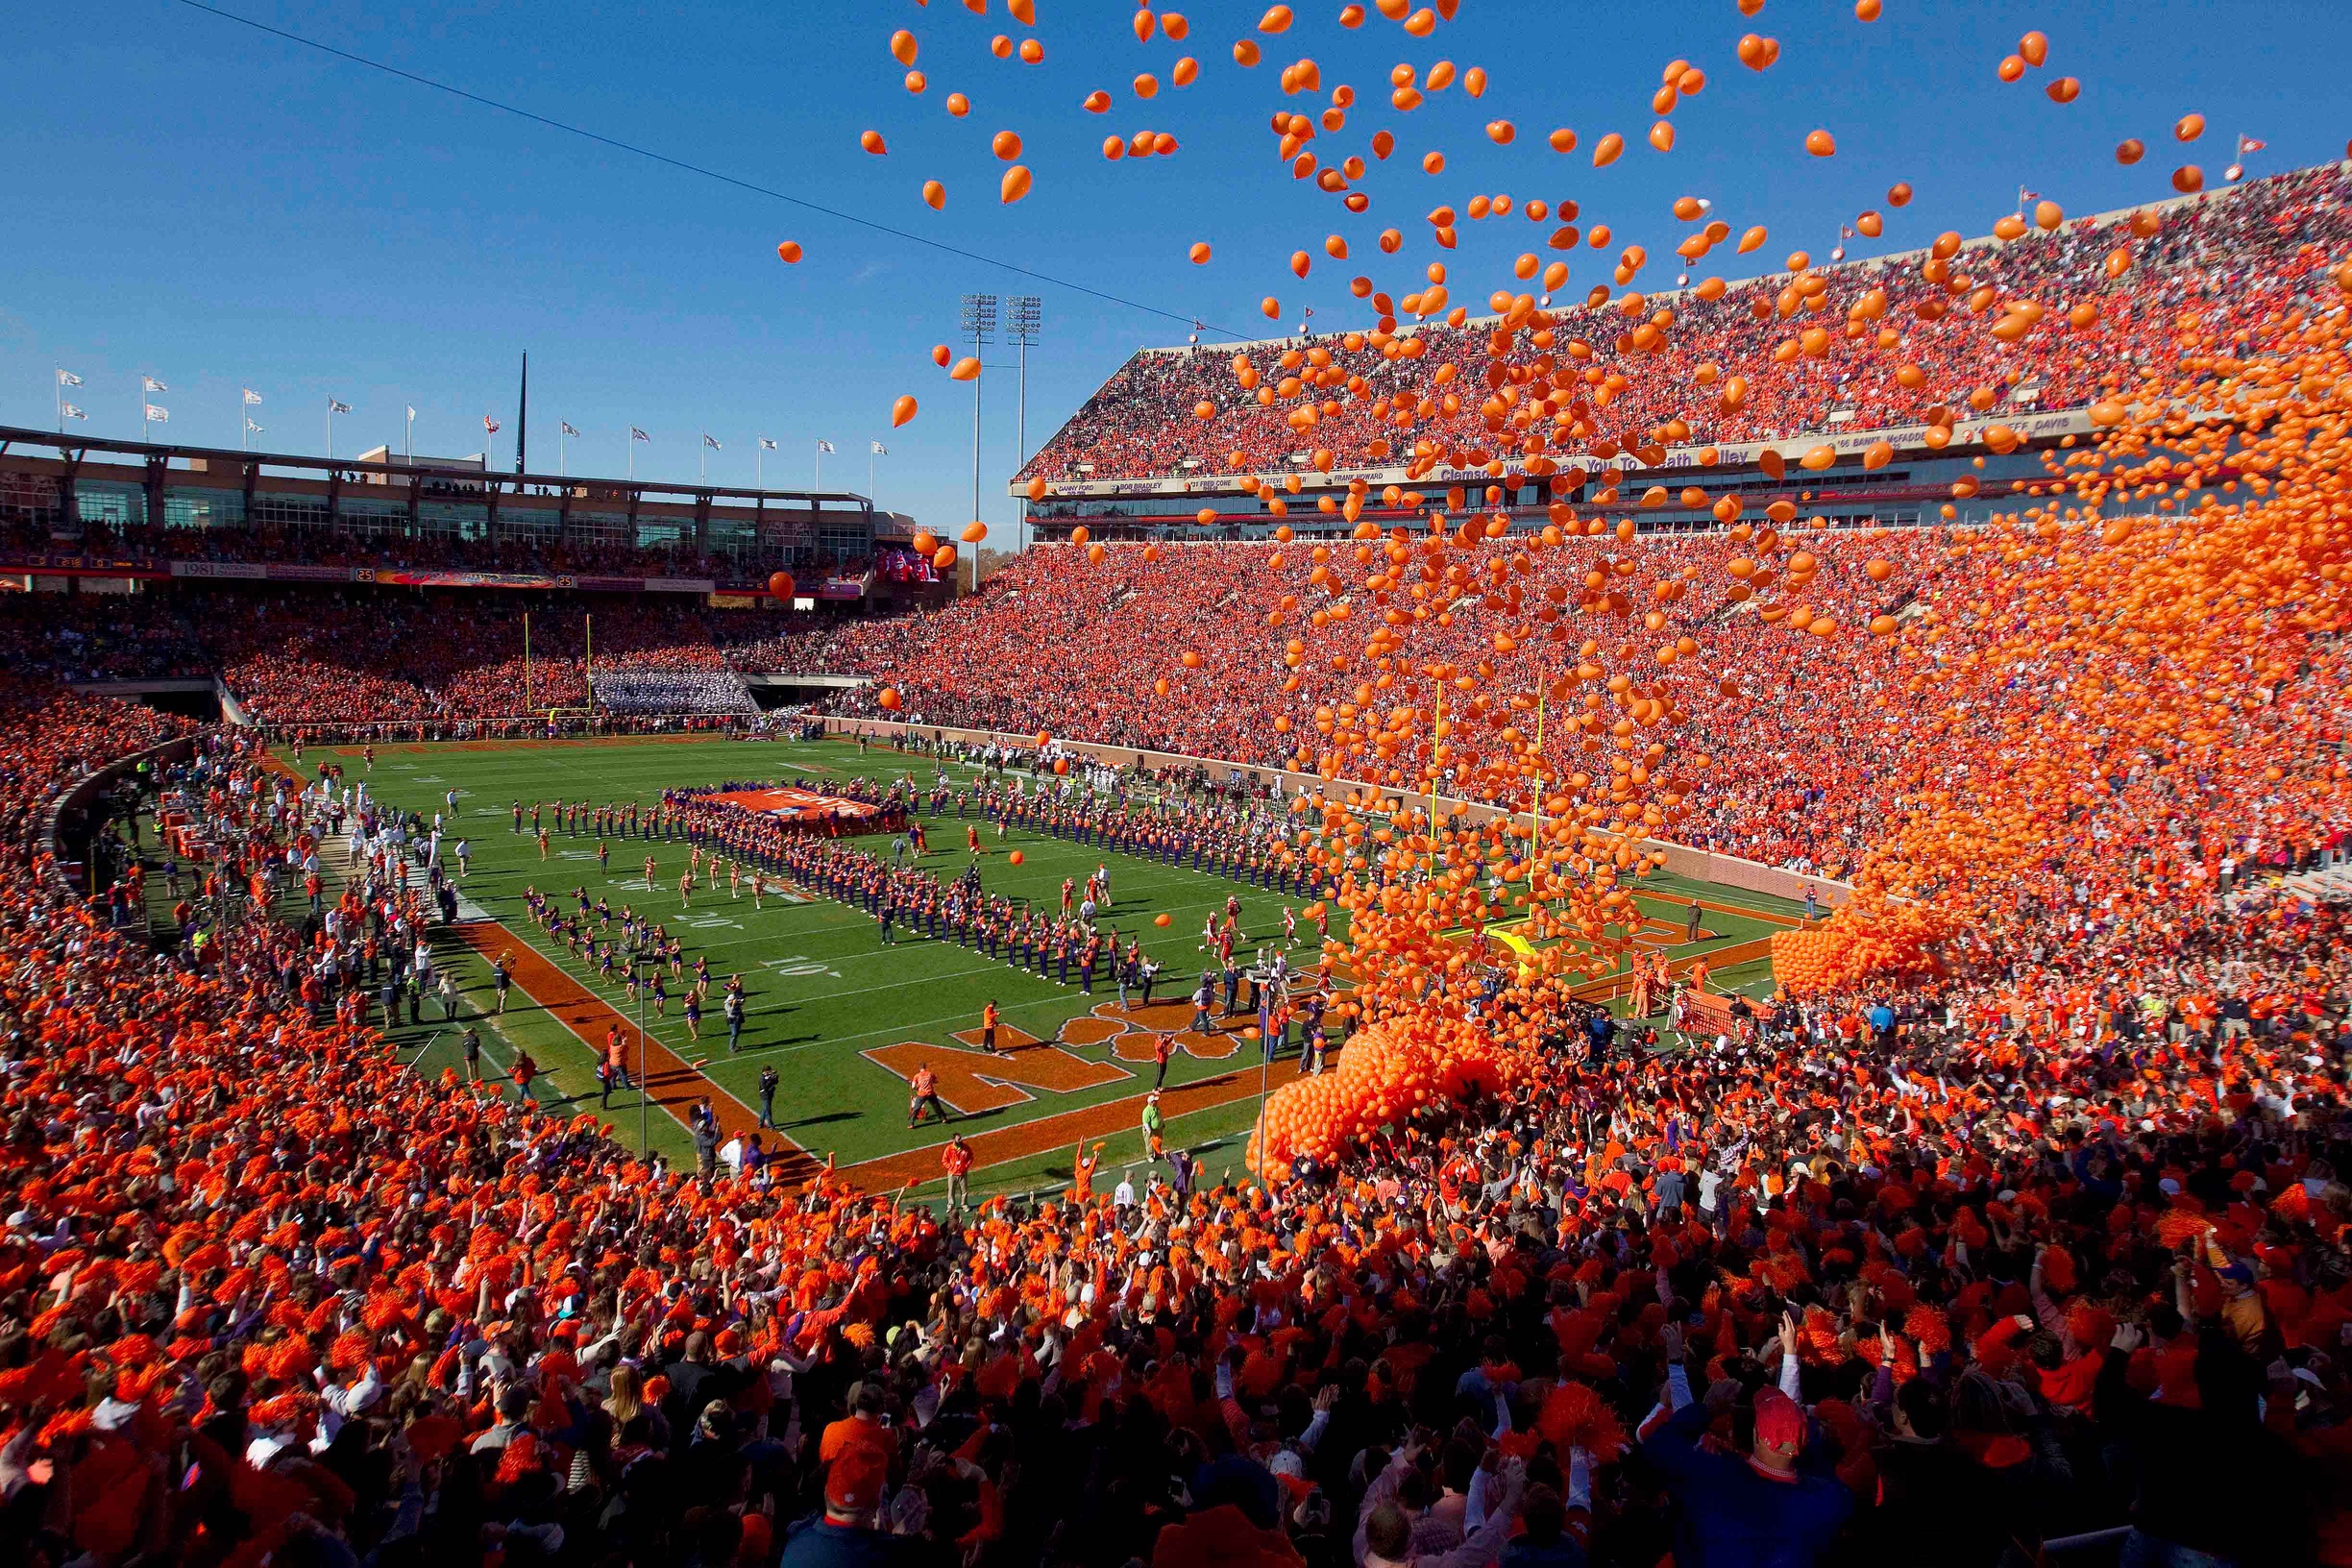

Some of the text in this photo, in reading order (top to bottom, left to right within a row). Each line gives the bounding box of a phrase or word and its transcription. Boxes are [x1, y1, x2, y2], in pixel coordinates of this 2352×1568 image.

[2034, 416, 2070, 430] DAVIS
[1886, 431, 1926, 444] McFADDE
[1440, 467, 1488, 481] Clemso
[1586, 458, 1613, 473] You
[1620, 456, 1637, 471] To
[1356, 472, 1384, 480] HOWARD
[1133, 481, 1162, 490] BRADLEY
[184, 563, 216, 576] 1981
[356, 570, 372, 580] 25
[558, 576, 572, 586] 25
